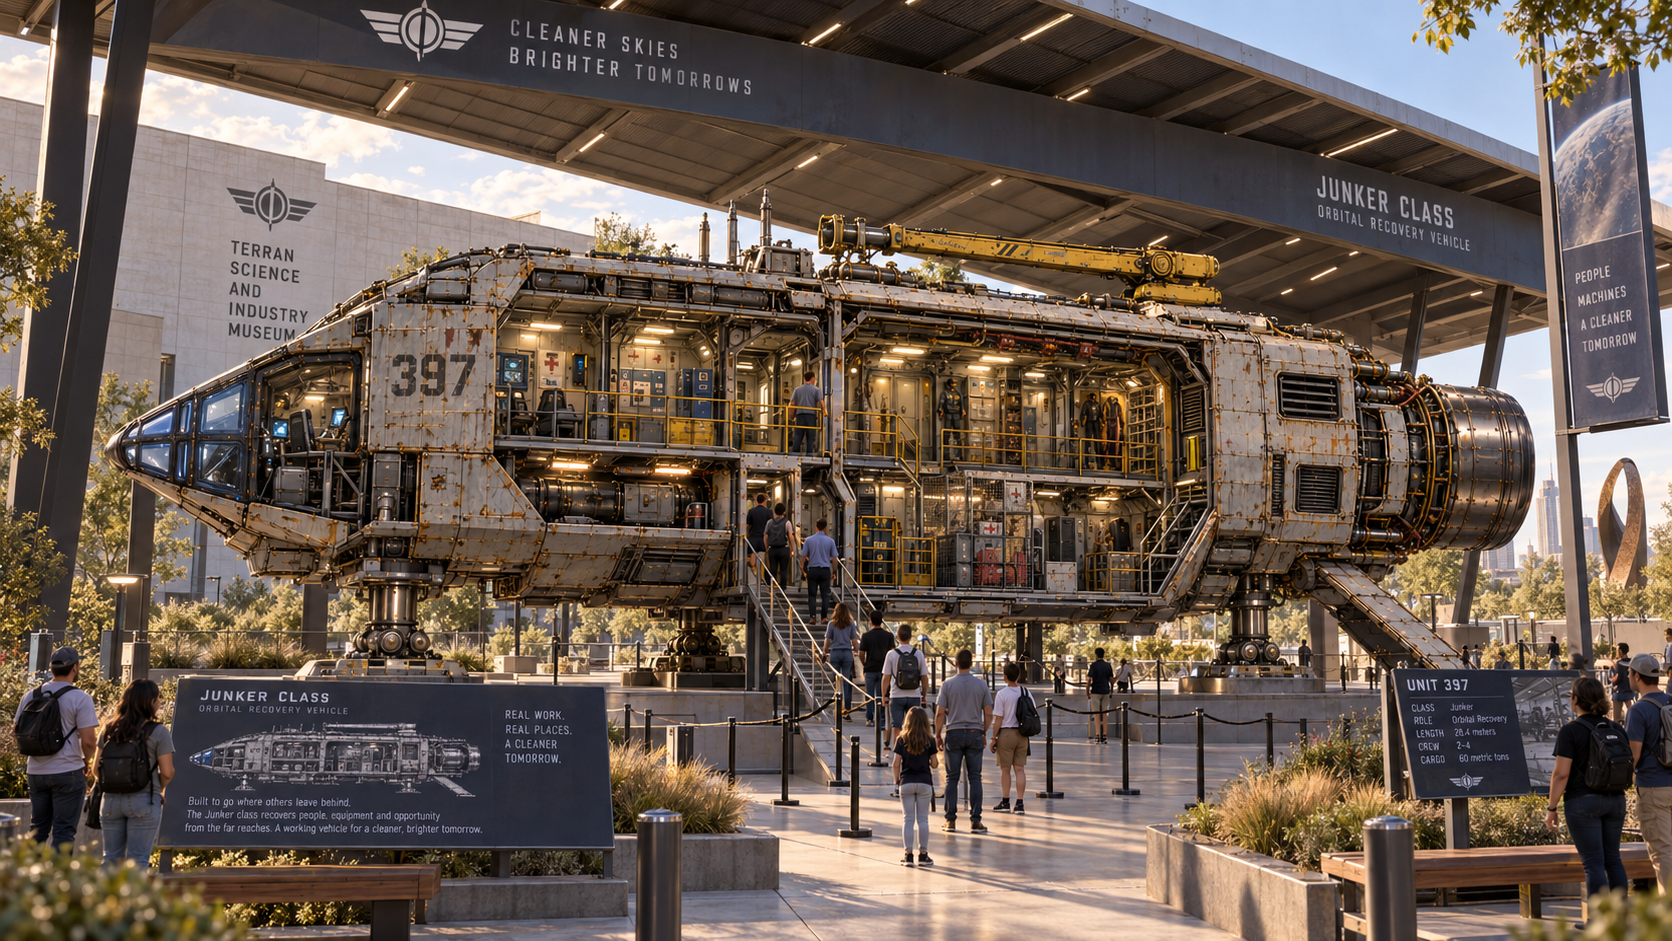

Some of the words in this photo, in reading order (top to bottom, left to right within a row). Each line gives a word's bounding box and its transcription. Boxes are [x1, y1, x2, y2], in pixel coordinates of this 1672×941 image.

[510, 18, 607, 49] CLEANER
[621, 35, 679, 60] SKIES
[509, 46, 619, 78] BRIGHTER
[635, 63, 752, 95] TOMORROWS
[1316, 175, 1389, 214] JUNKER
[1400, 195, 1454, 229] CLASS
[1317, 204, 1364, 227] ORBITAL
[1370, 216, 1425, 241] RECOVERY
[1430, 230, 1471, 252] VEHICLE
[231, 240, 294, 263] TERRAN
[230, 261, 300, 284] SCIENCE
[1575, 265, 1611, 285] PEOPLE
[229, 281, 261, 298] AND
[1577, 285, 1627, 308] MACHINES
[229, 301, 309, 324] INDUSTRY
[1581, 318, 1587, 331] A
[1590, 309, 1632, 330] CLEANER
[228, 322, 296, 342] MUSEUM
[1582, 331, 1637, 353] TOMORROW
[391, 354, 476, 397] 397
[1407, 678, 1438, 692] UNIT
[1444, 678, 1469, 692] 397
[200, 689, 268, 702] JUNKER
[278, 691, 330, 704] CLASS
[198, 704, 242, 713] ORBITAL
[248, 706, 301, 714] RECOVERY
[306, 706, 349, 715] VEHICLE
[505, 709, 530, 720] REAL
[534, 710, 565, 721] WORK.
[1411, 703, 1436, 713] CLASS
[1413, 716, 1433, 725] ROLE
[505, 724, 530, 735] REAL
[534, 725, 573, 736] PLACES.
[1416, 729, 1445, 739] LENGTH
[504, 739, 511, 749] A
[514, 738, 558, 749] CLEANER
[1418, 742, 1440, 752] CREW
[504, 753, 562, 764] TOMORROW.
[1470, 753, 1493, 763] metric
[1494, 752, 1510, 762] tons
[188, 796, 209, 806] Built
[211, 797, 221, 806] to
[222, 798, 234, 808] go
[237, 798, 263, 807] where
[265, 797, 293, 807] others
[295, 798, 318, 807] leave
[320, 797, 352, 808] behind.
[187, 809, 203, 819] The
[204, 809, 235, 820] Junker
[236, 810, 259, 820] class
[260, 812, 296, 820] recovers
[330, 810, 374, 821] equipment
[375, 811, 392, 821] and
[393, 811, 441, 822] opportunity
[184, 822, 205, 832] from
[207, 822, 221, 833] the
[223, 822, 236, 833] far
[237, 823, 273, 833] reaches.
[274, 824, 281, 833] A
[283, 823, 317, 834] working
[318, 823, 348, 833] vehicle
[350, 823, 362, 834] for
[363, 826, 370, 834] a
[372, 823, 404, 835] cleaner,
[406, 823, 439, 835] brighter
[441, 825, 483, 834] tomorrow.
